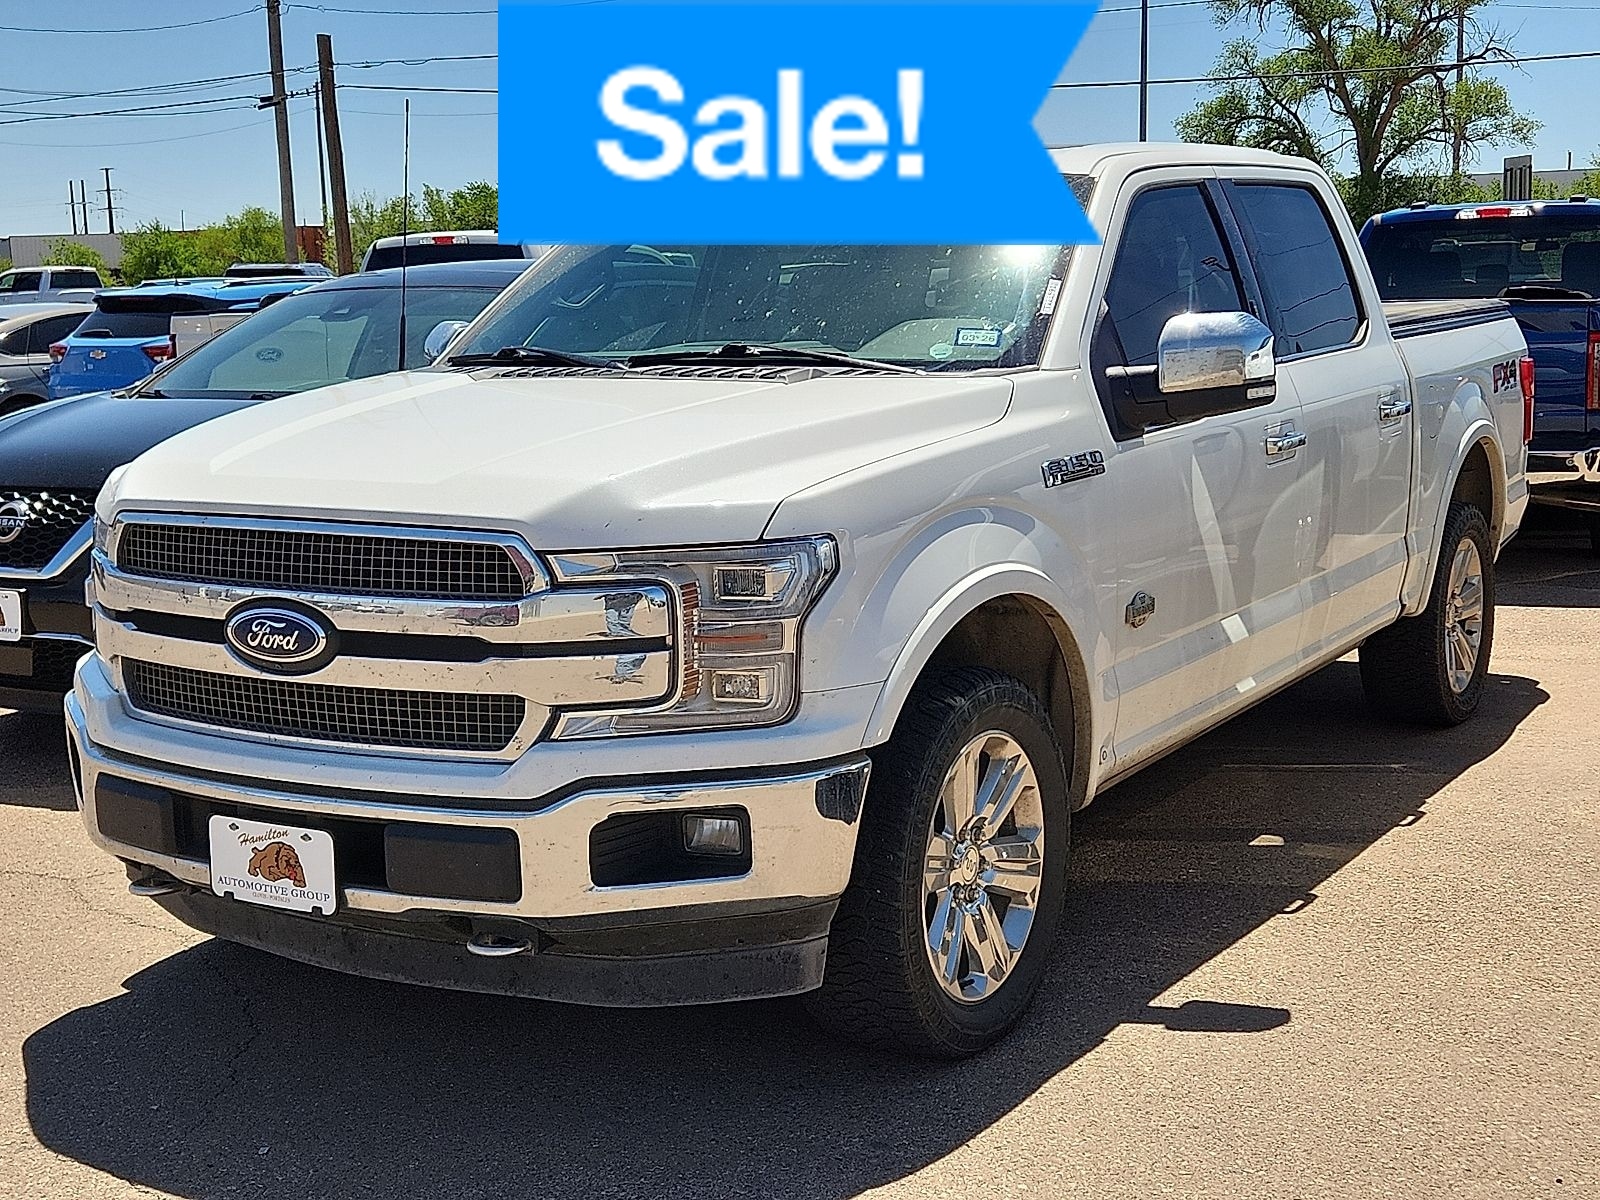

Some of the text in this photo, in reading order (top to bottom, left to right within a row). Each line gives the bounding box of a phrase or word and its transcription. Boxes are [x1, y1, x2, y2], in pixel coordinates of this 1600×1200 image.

[1492, 359, 1517, 394] FX4
[247, 619, 299, 650] Ford
[237, 828, 290, 847] Hamilton
[217, 875, 330, 902] AUTOMOTIVE GROUP
